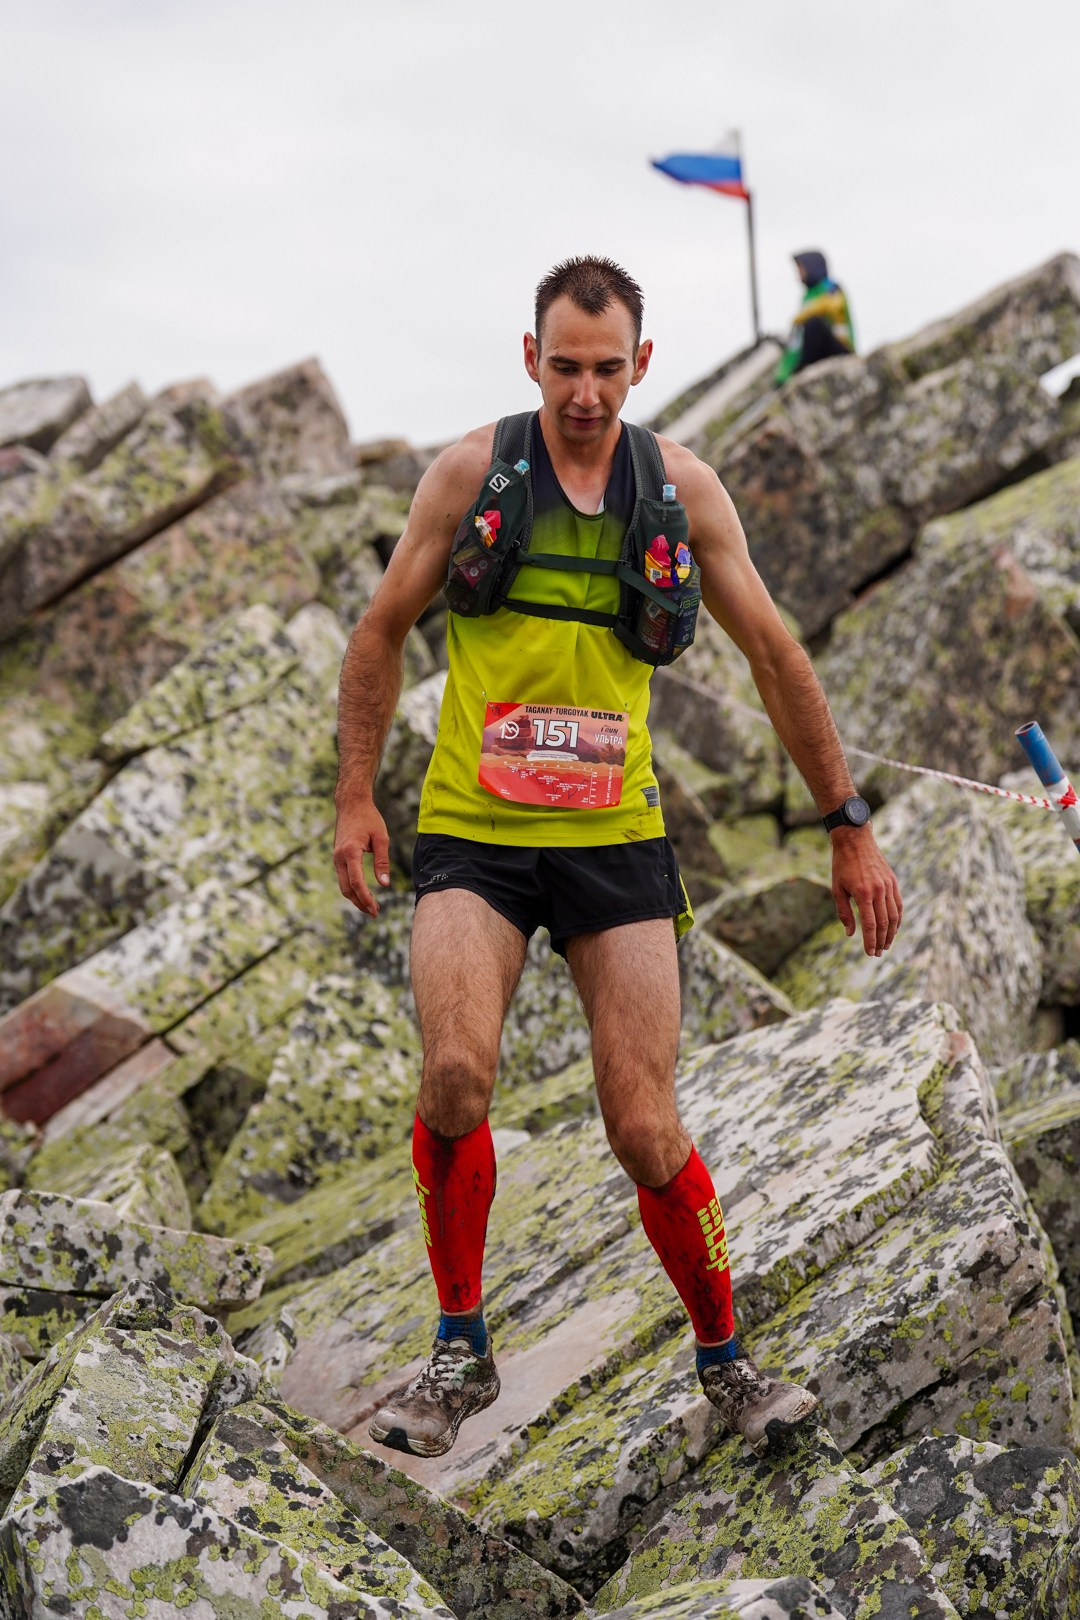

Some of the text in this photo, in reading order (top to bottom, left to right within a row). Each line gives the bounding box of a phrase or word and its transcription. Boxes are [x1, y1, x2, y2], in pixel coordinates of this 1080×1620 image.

[525, 705, 624, 722] TAGANAY-TURGOYAK ULTRA
[532, 718, 580, 749] 151
[594, 733, 623, 746] УЛЬТРА
